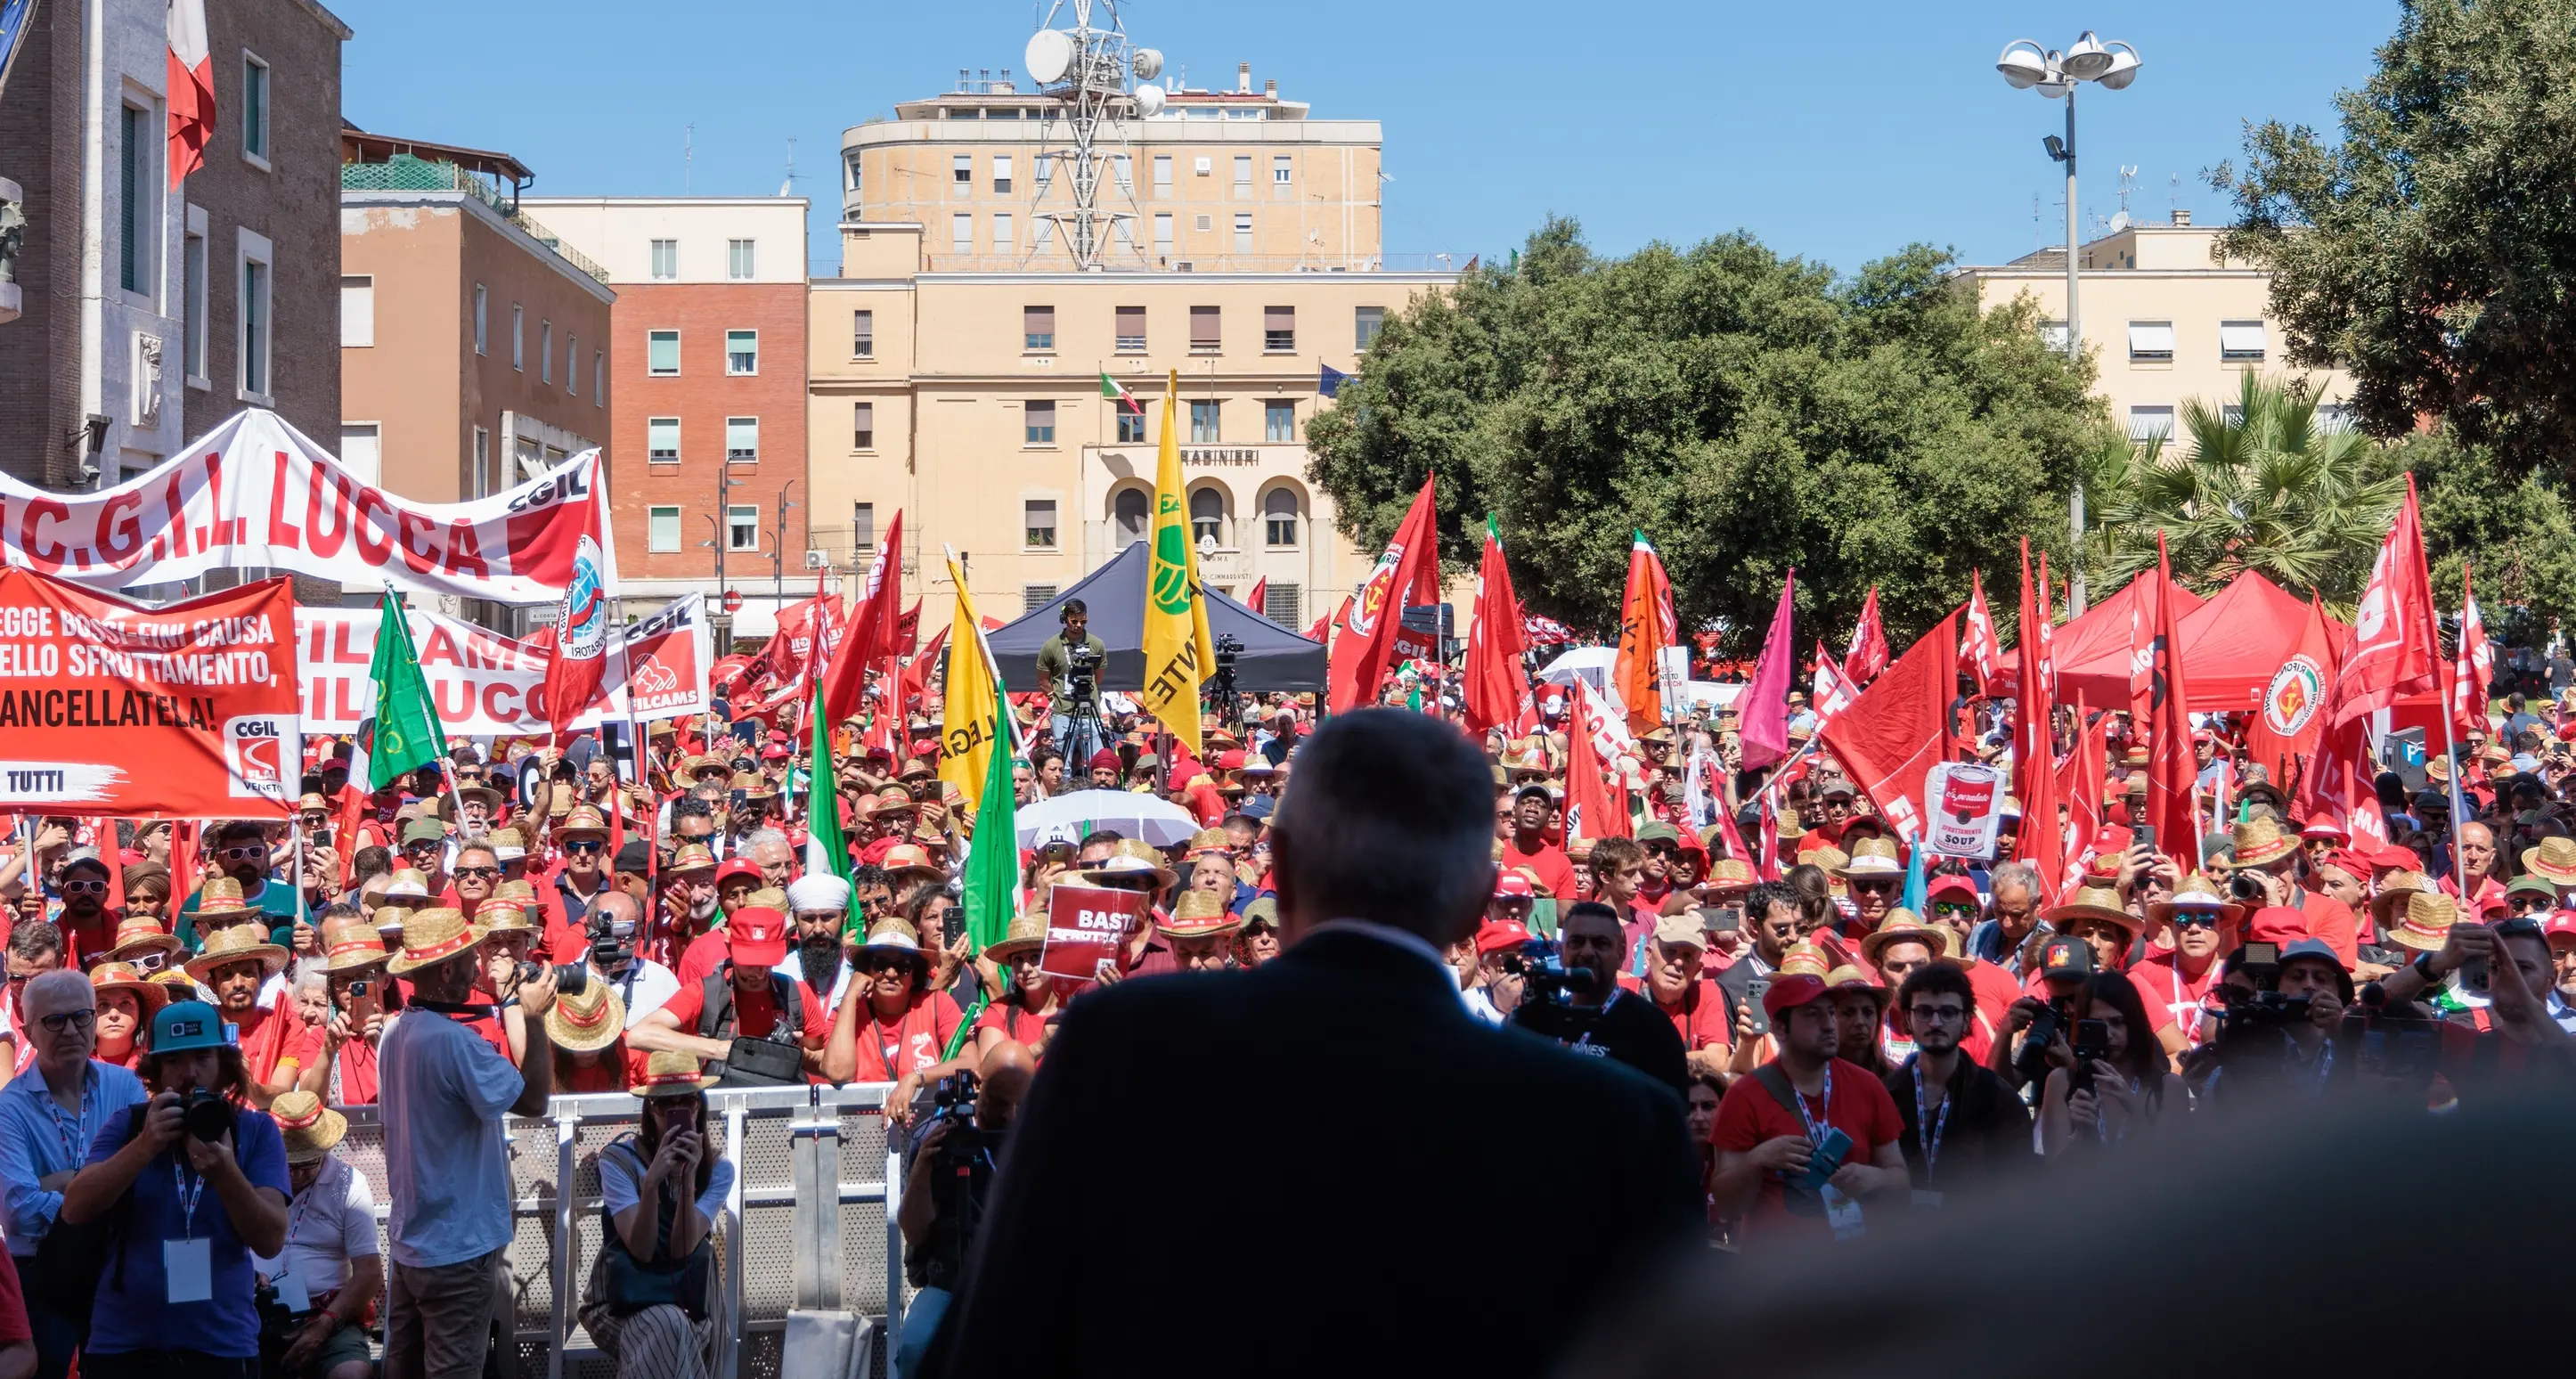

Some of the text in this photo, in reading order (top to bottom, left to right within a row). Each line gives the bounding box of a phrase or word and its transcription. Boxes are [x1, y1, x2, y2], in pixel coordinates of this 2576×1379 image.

[508, 469, 588, 512] CGIL
[20, 451, 490, 581] C.G.I.L. LUCCA
[60, 608, 186, 649] BOSSI-FINI
[193, 614, 274, 648] CAUSA
[626, 605, 692, 640] CGIL
[69, 643, 277, 688] SFRUTTAMENTO,
[0, 690, 217, 731] ANCELLATELA!
[235, 722, 280, 738] CGIL
[7, 770, 64, 793] TUTTI
[243, 781, 283, 792] VENETO
[1941, 825, 1982, 835] SFRUTTAMENTO
[1944, 835, 1975, 845] SOUP
[1079, 910, 1137, 931] BASTA
